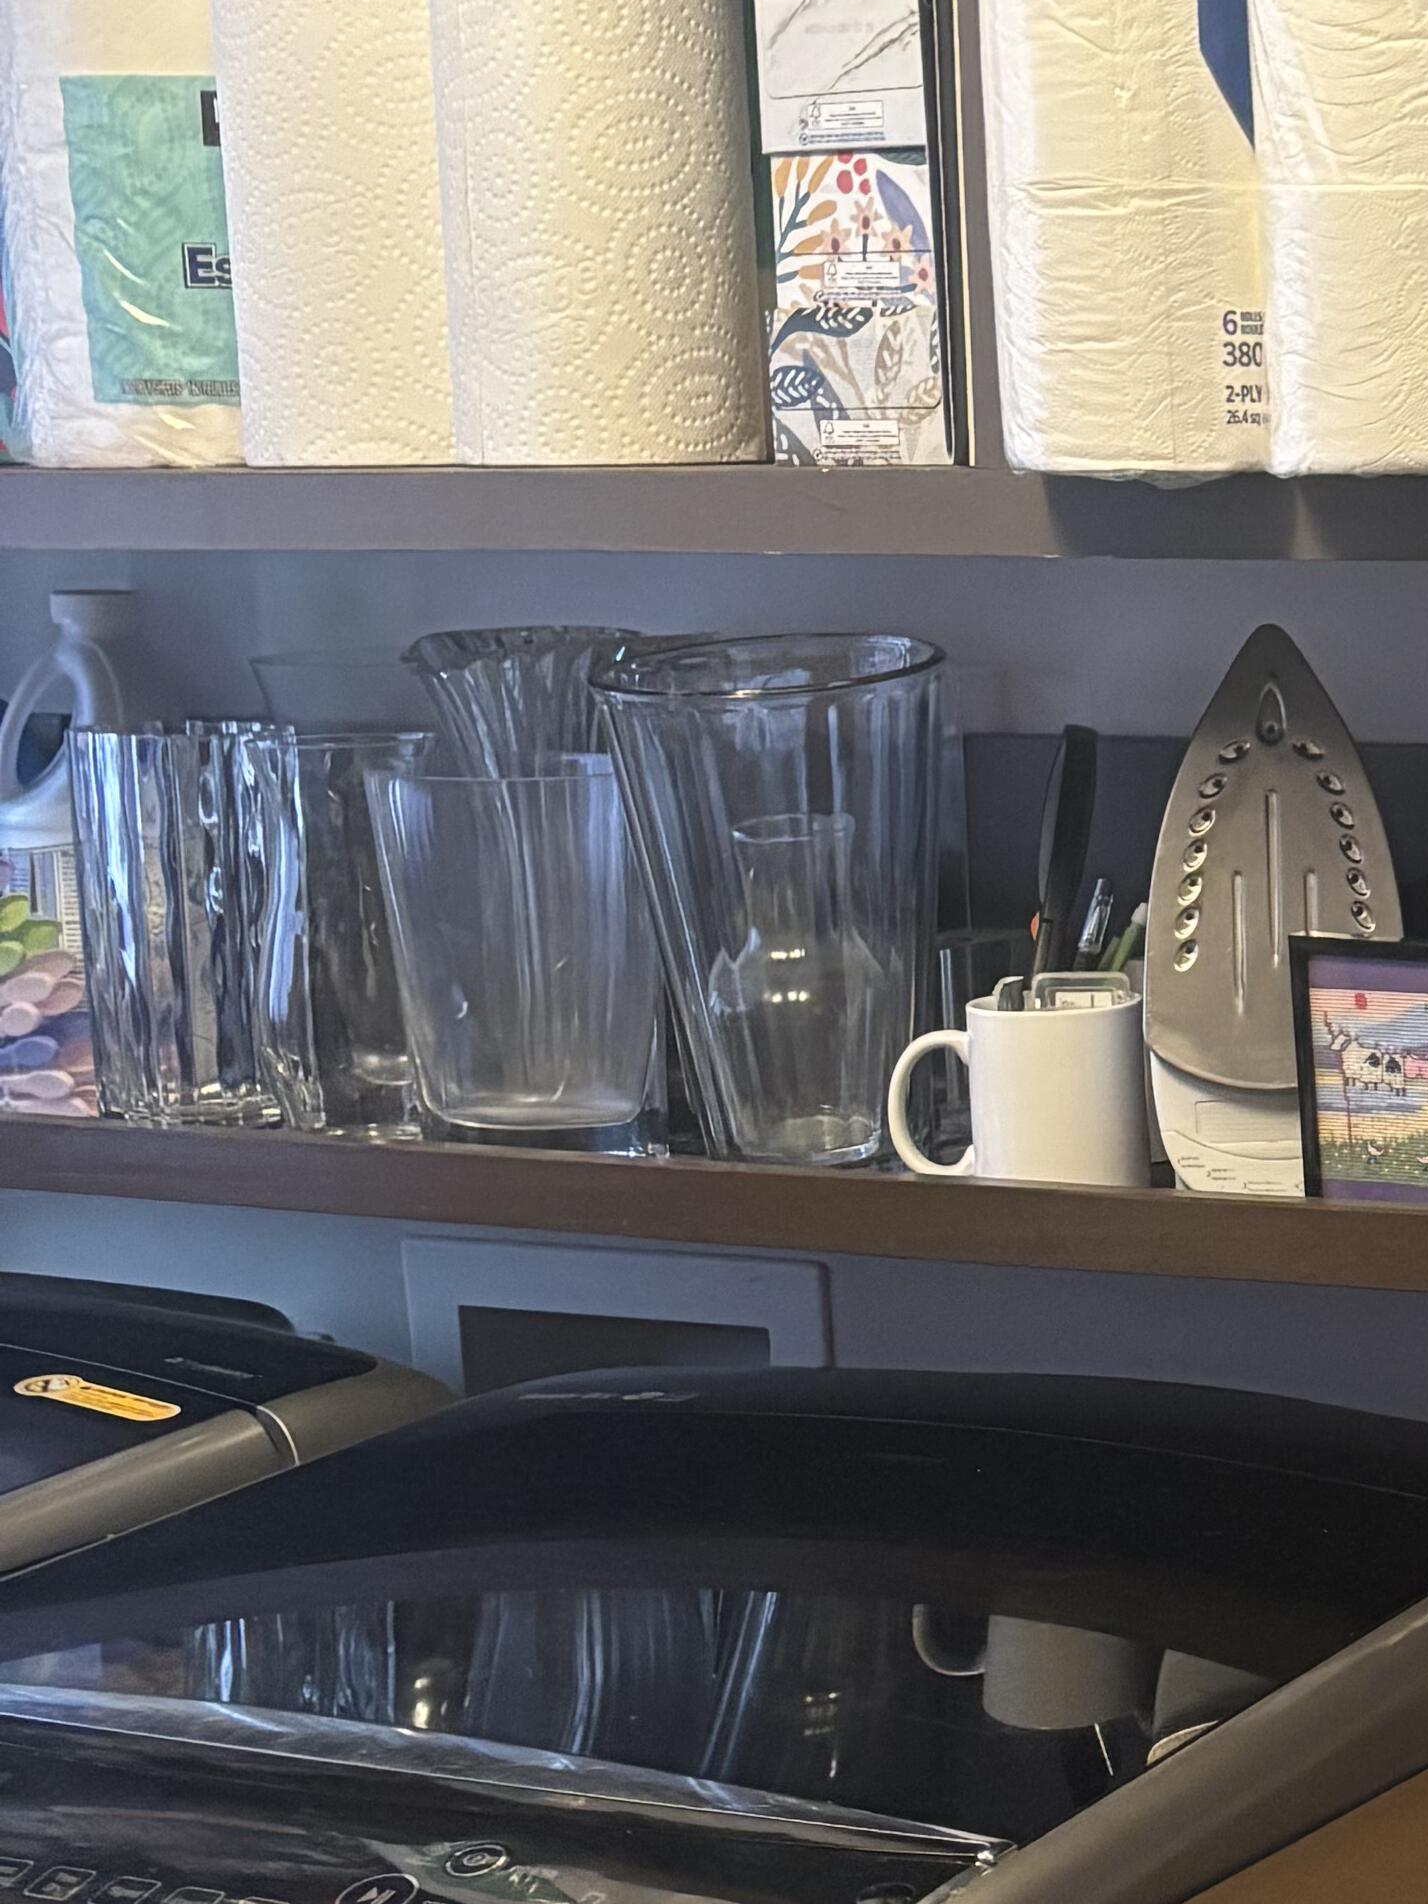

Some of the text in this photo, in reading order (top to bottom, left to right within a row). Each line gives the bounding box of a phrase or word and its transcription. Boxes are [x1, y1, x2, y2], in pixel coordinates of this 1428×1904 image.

[1223, 310, 1238, 335] 6
[1223, 342, 1262, 368] 380
[1225, 385, 1262, 403] 2-PLY
